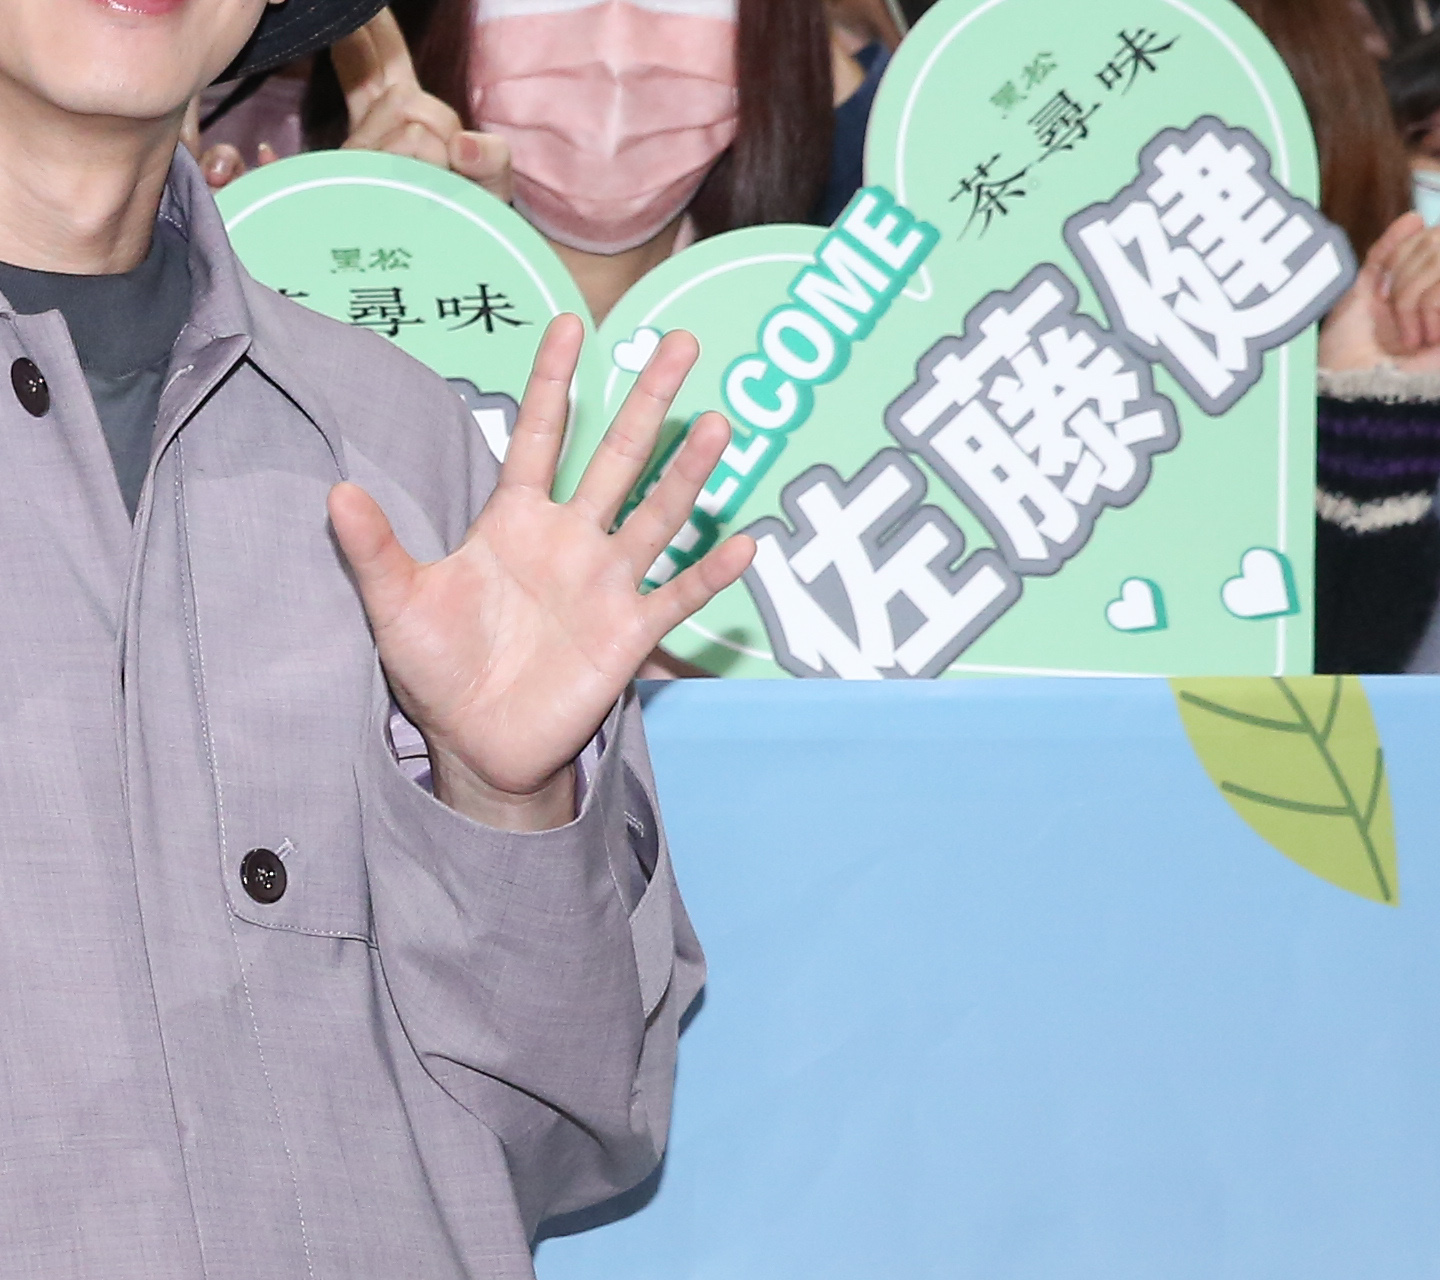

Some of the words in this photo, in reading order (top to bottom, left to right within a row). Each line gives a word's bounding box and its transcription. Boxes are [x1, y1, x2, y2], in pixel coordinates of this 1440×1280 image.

[948, 28, 1181, 241] 茶尋味
[277, 283, 534, 337] 尋味
[329, 247, 413, 274] 黑松
[745, 128, 1340, 678] 佐藤健
